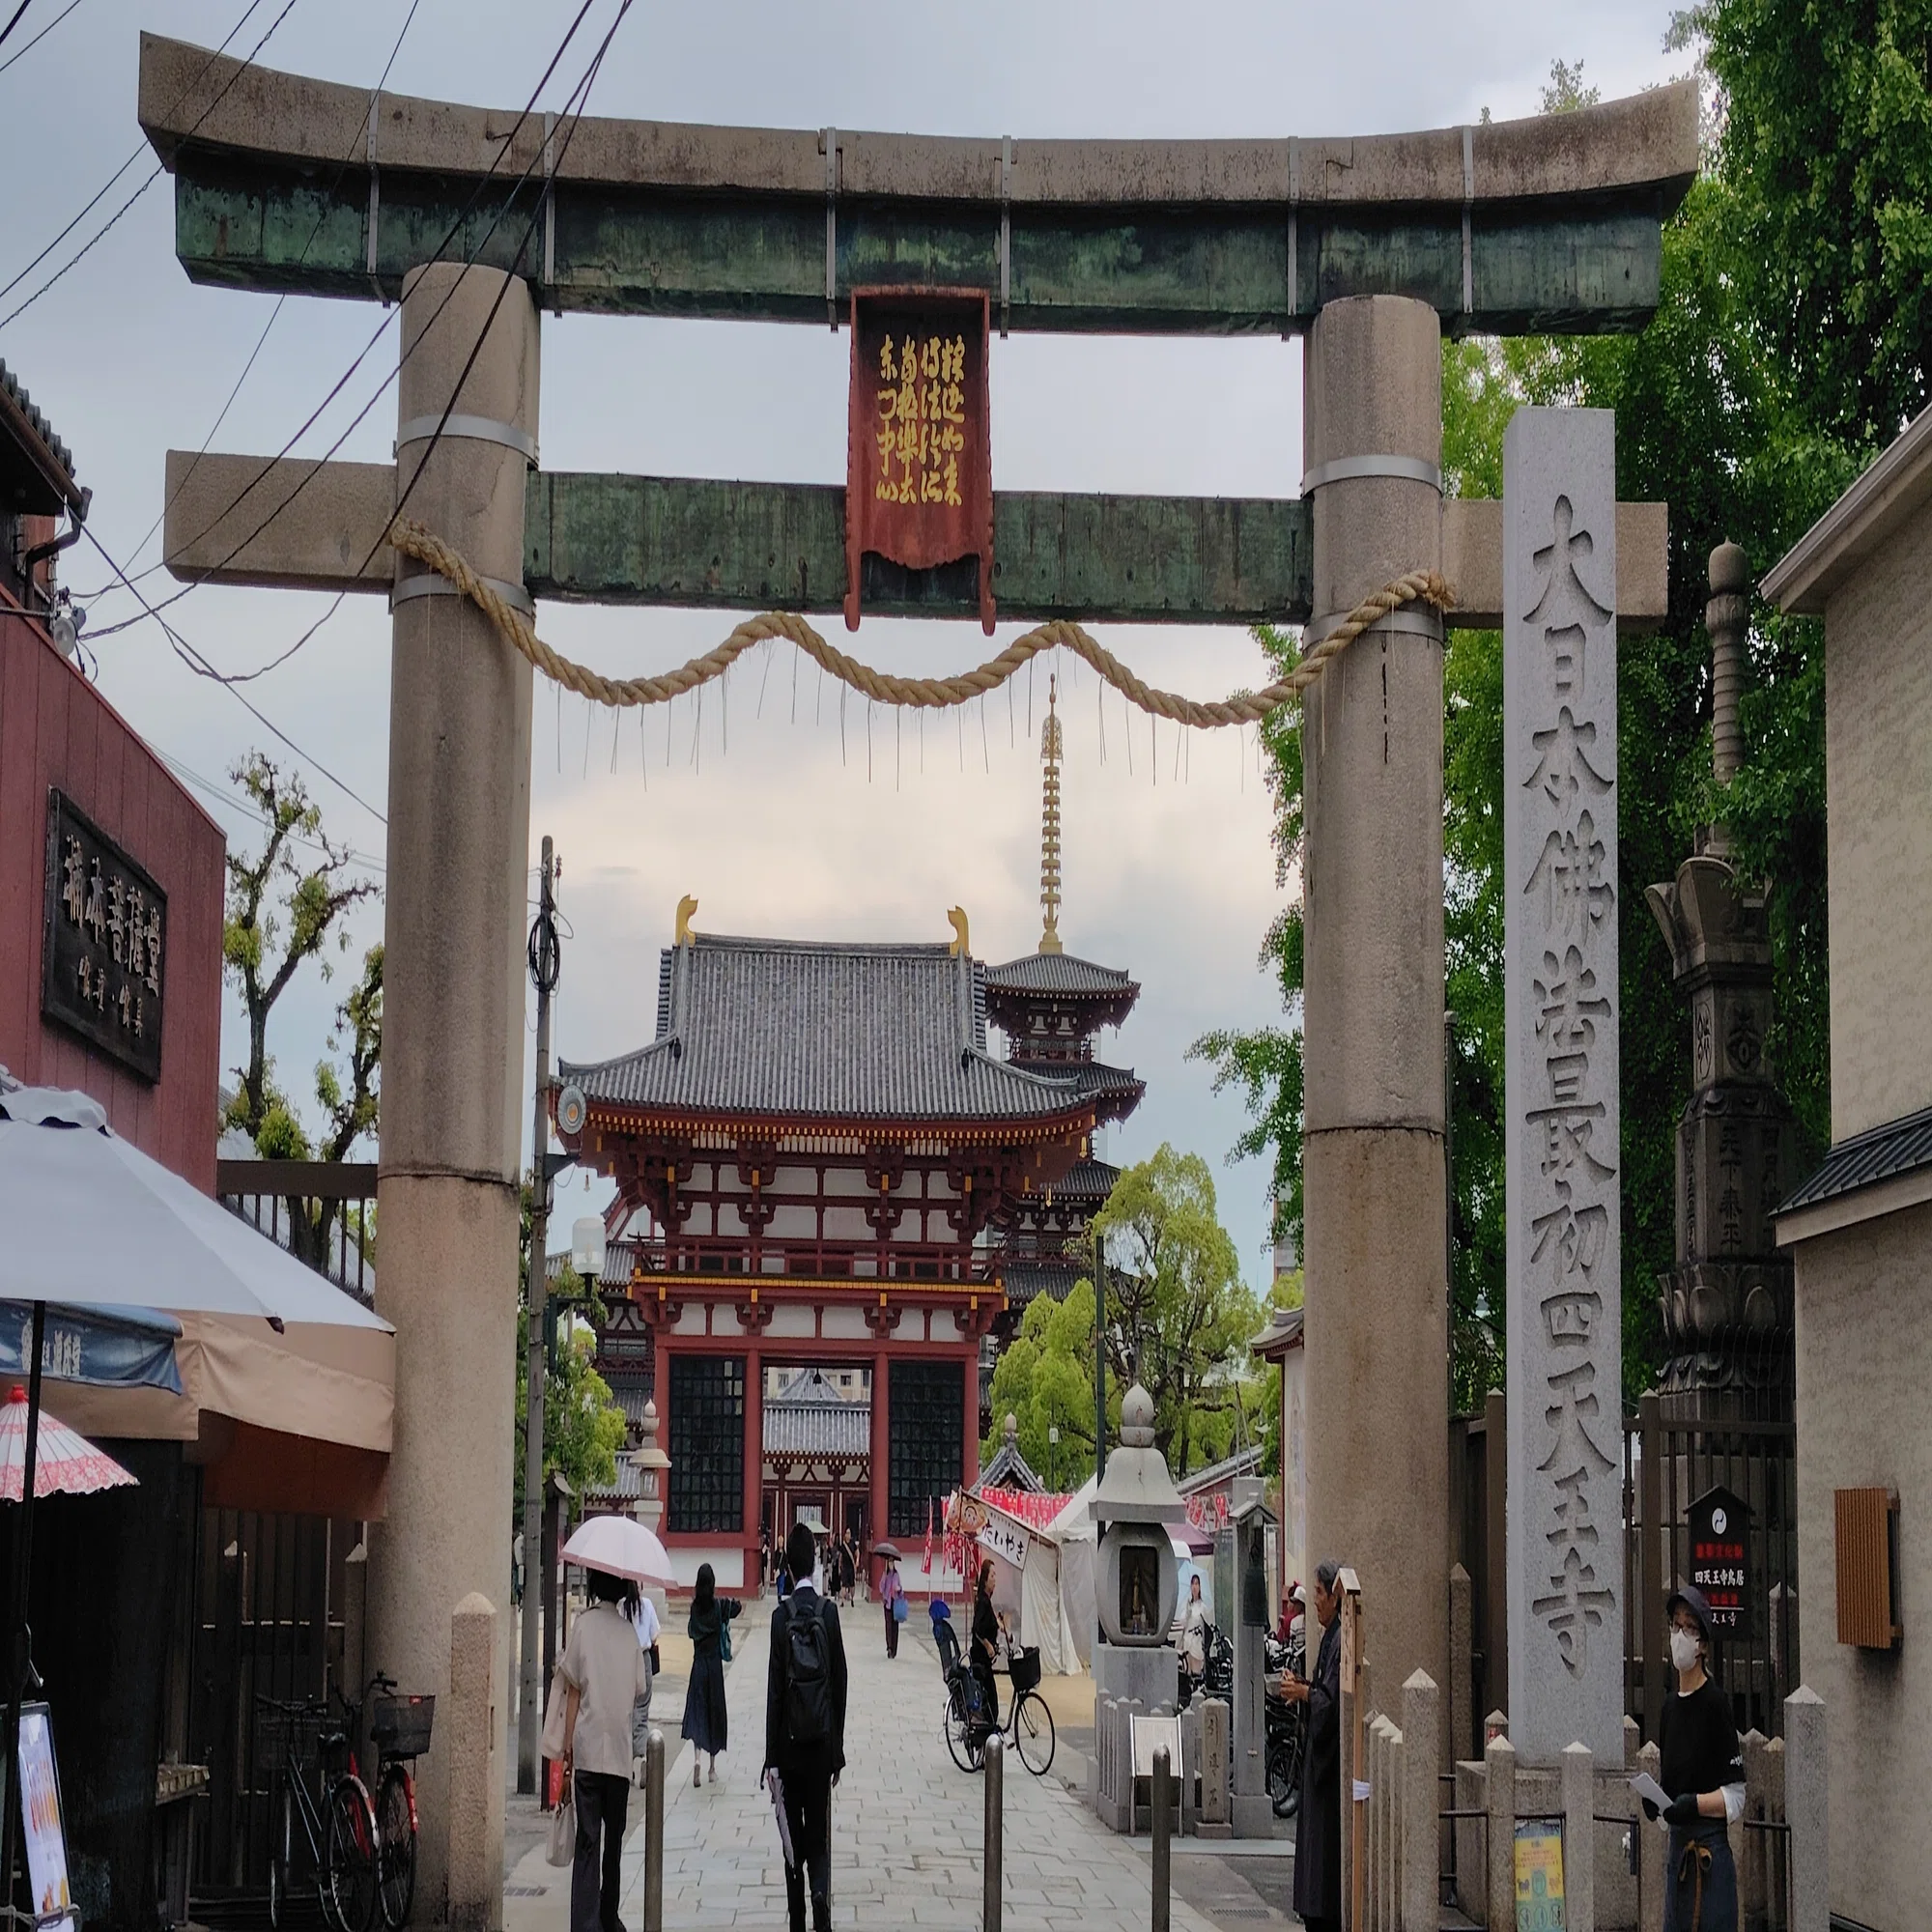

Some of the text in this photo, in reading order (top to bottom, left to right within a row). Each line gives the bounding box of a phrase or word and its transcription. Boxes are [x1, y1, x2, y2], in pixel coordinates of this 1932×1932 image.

[982, 1518, 1024, 1562] たいやき
[1694, 1568, 1745, 1586] 四天王寺鳥居
